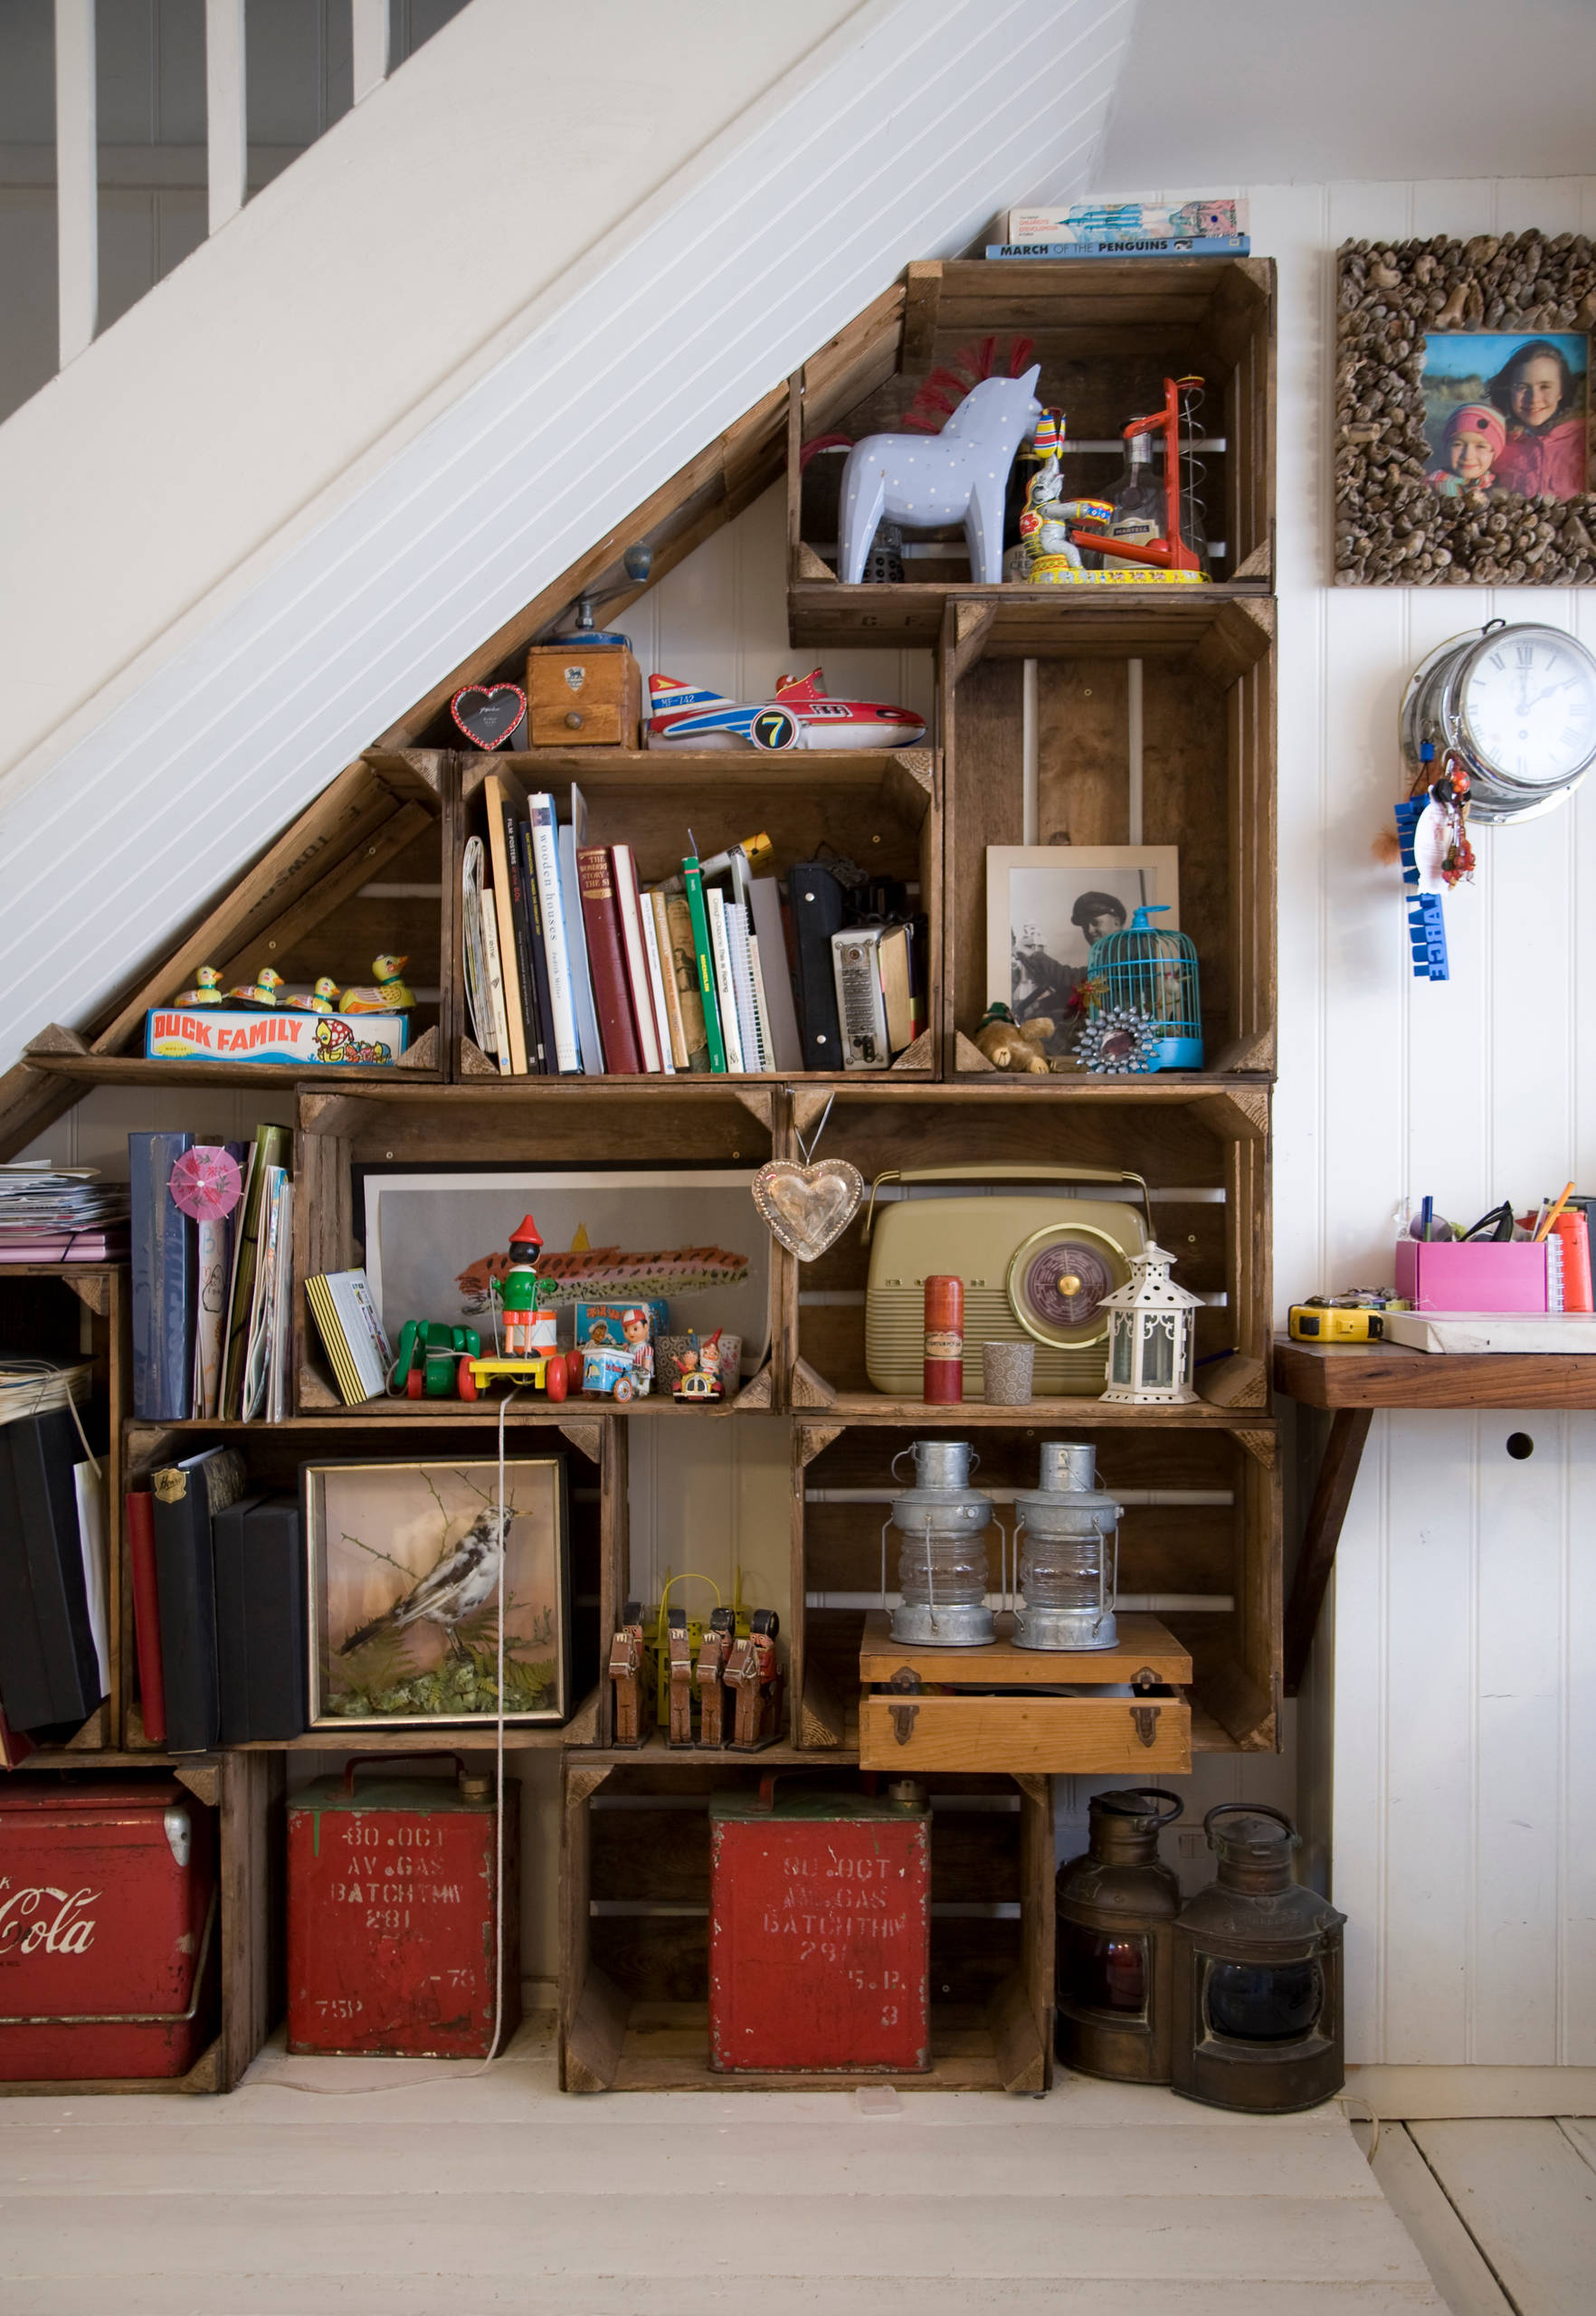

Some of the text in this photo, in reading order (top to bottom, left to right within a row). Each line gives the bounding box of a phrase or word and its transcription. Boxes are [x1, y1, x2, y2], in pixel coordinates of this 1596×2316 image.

[1000, 240, 1168, 257] MARCH OF THE PENGUINS
[660, 694, 695, 707] MF-742
[762, 717, 784, 747] 7
[508, 836, 517, 865] POSTERS
[540, 834, 553, 887] wooden
[589, 855, 605, 863] THE
[545, 893, 557, 941] houses
[700, 954, 709, 992] MICHELIN
[154, 1014, 303, 1052] DUCK FAMILY
[0, 1887, 104, 1954] Cola
